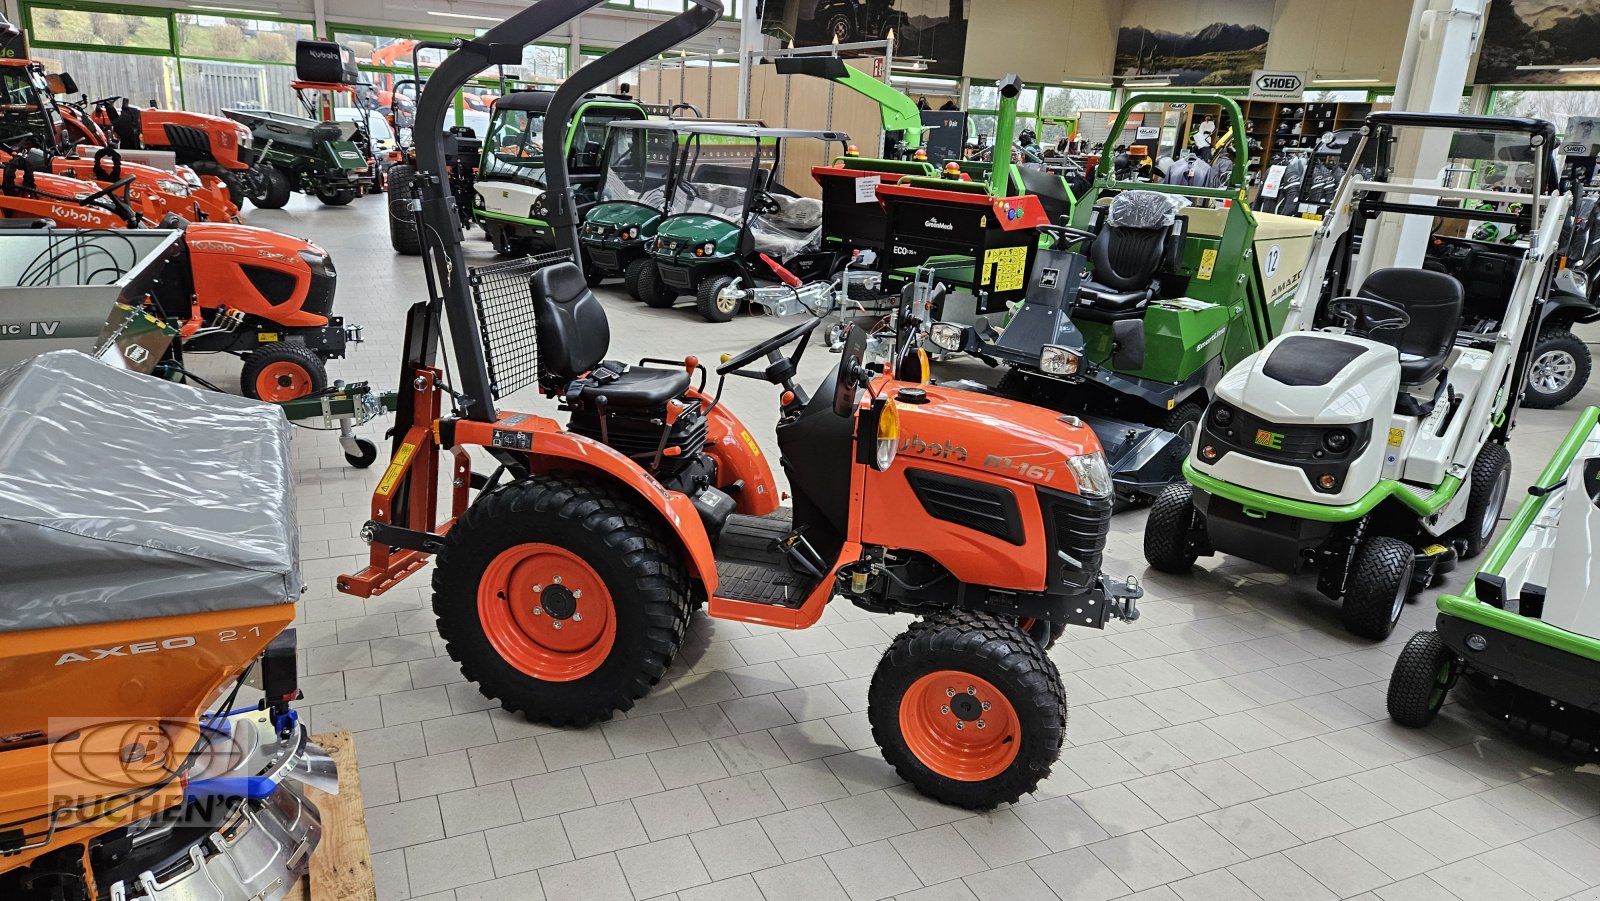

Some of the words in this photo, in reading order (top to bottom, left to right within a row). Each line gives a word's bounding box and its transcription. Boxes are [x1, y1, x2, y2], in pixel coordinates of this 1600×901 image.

[309, 50, 339, 60] Kubota
[1263, 78, 1296, 89] SHOEI
[51, 204, 102, 225] Kubota
[924, 220, 954, 231] GreenMech
[190, 240, 236, 253] Kubota
[1267, 249, 1279, 273] 12
[29, 321, 61, 336] IV
[899, 434, 968, 462] ubota
[982, 453, 1055, 482] B1-161
[54, 636, 197, 666] AXEO
[217, 626, 261, 643] 2.1
